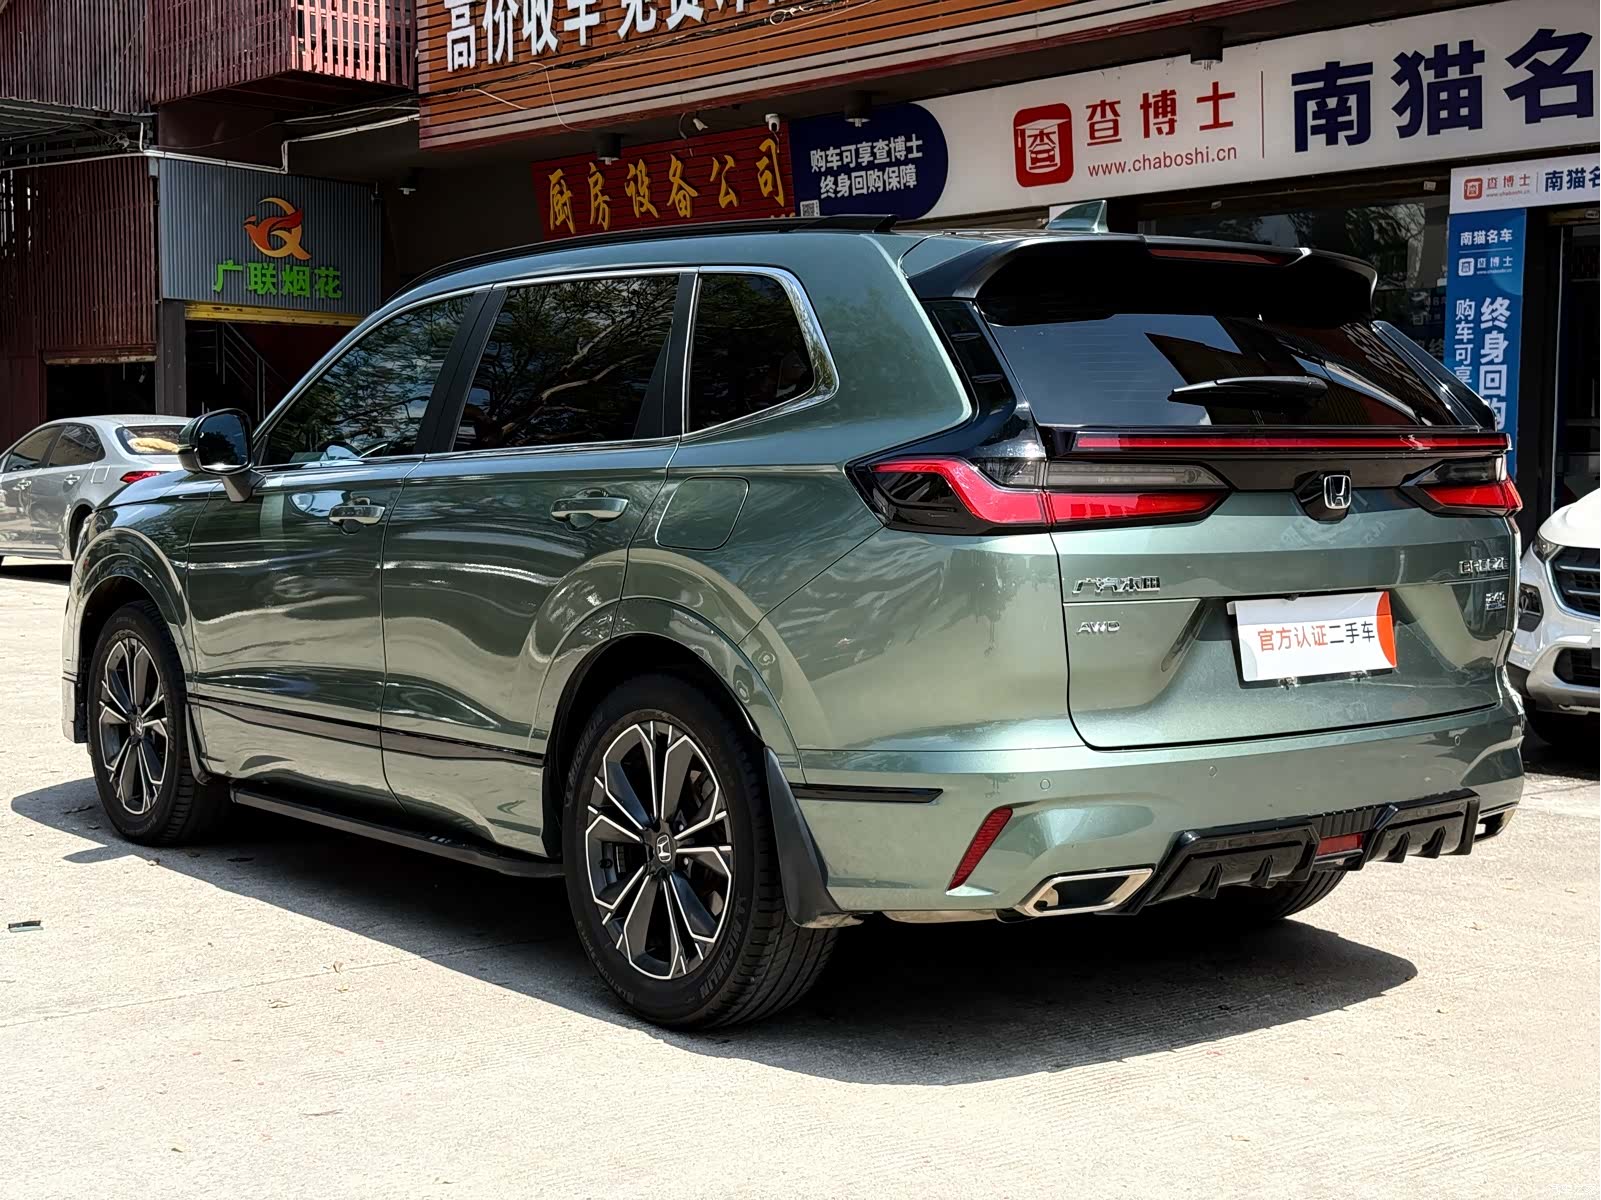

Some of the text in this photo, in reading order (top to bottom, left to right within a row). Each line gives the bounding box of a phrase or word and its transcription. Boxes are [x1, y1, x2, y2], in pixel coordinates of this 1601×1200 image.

[1291, 28, 1594, 153] 南猫名
[1085, 81, 1236, 146] 查博士
[810, 133, 923, 173] 购车可享查博士
[1087, 146, 1238, 177] www.chaboshi.cn
[548, 138, 784, 234] 厨房设备公司
[820, 163, 917, 199] 终身回购保障
[1486, 174, 1531, 190] 查博士
[1460, 228, 1513, 246] 南猫名车
[213, 259, 342, 298] 广联烟花
[1476, 256, 1513, 269] 查博士
[1454, 298, 1476, 383] 购车可享
[1077, 621, 1120, 633] AWD
[1257, 620, 1375, 652] 官方认证二手车
